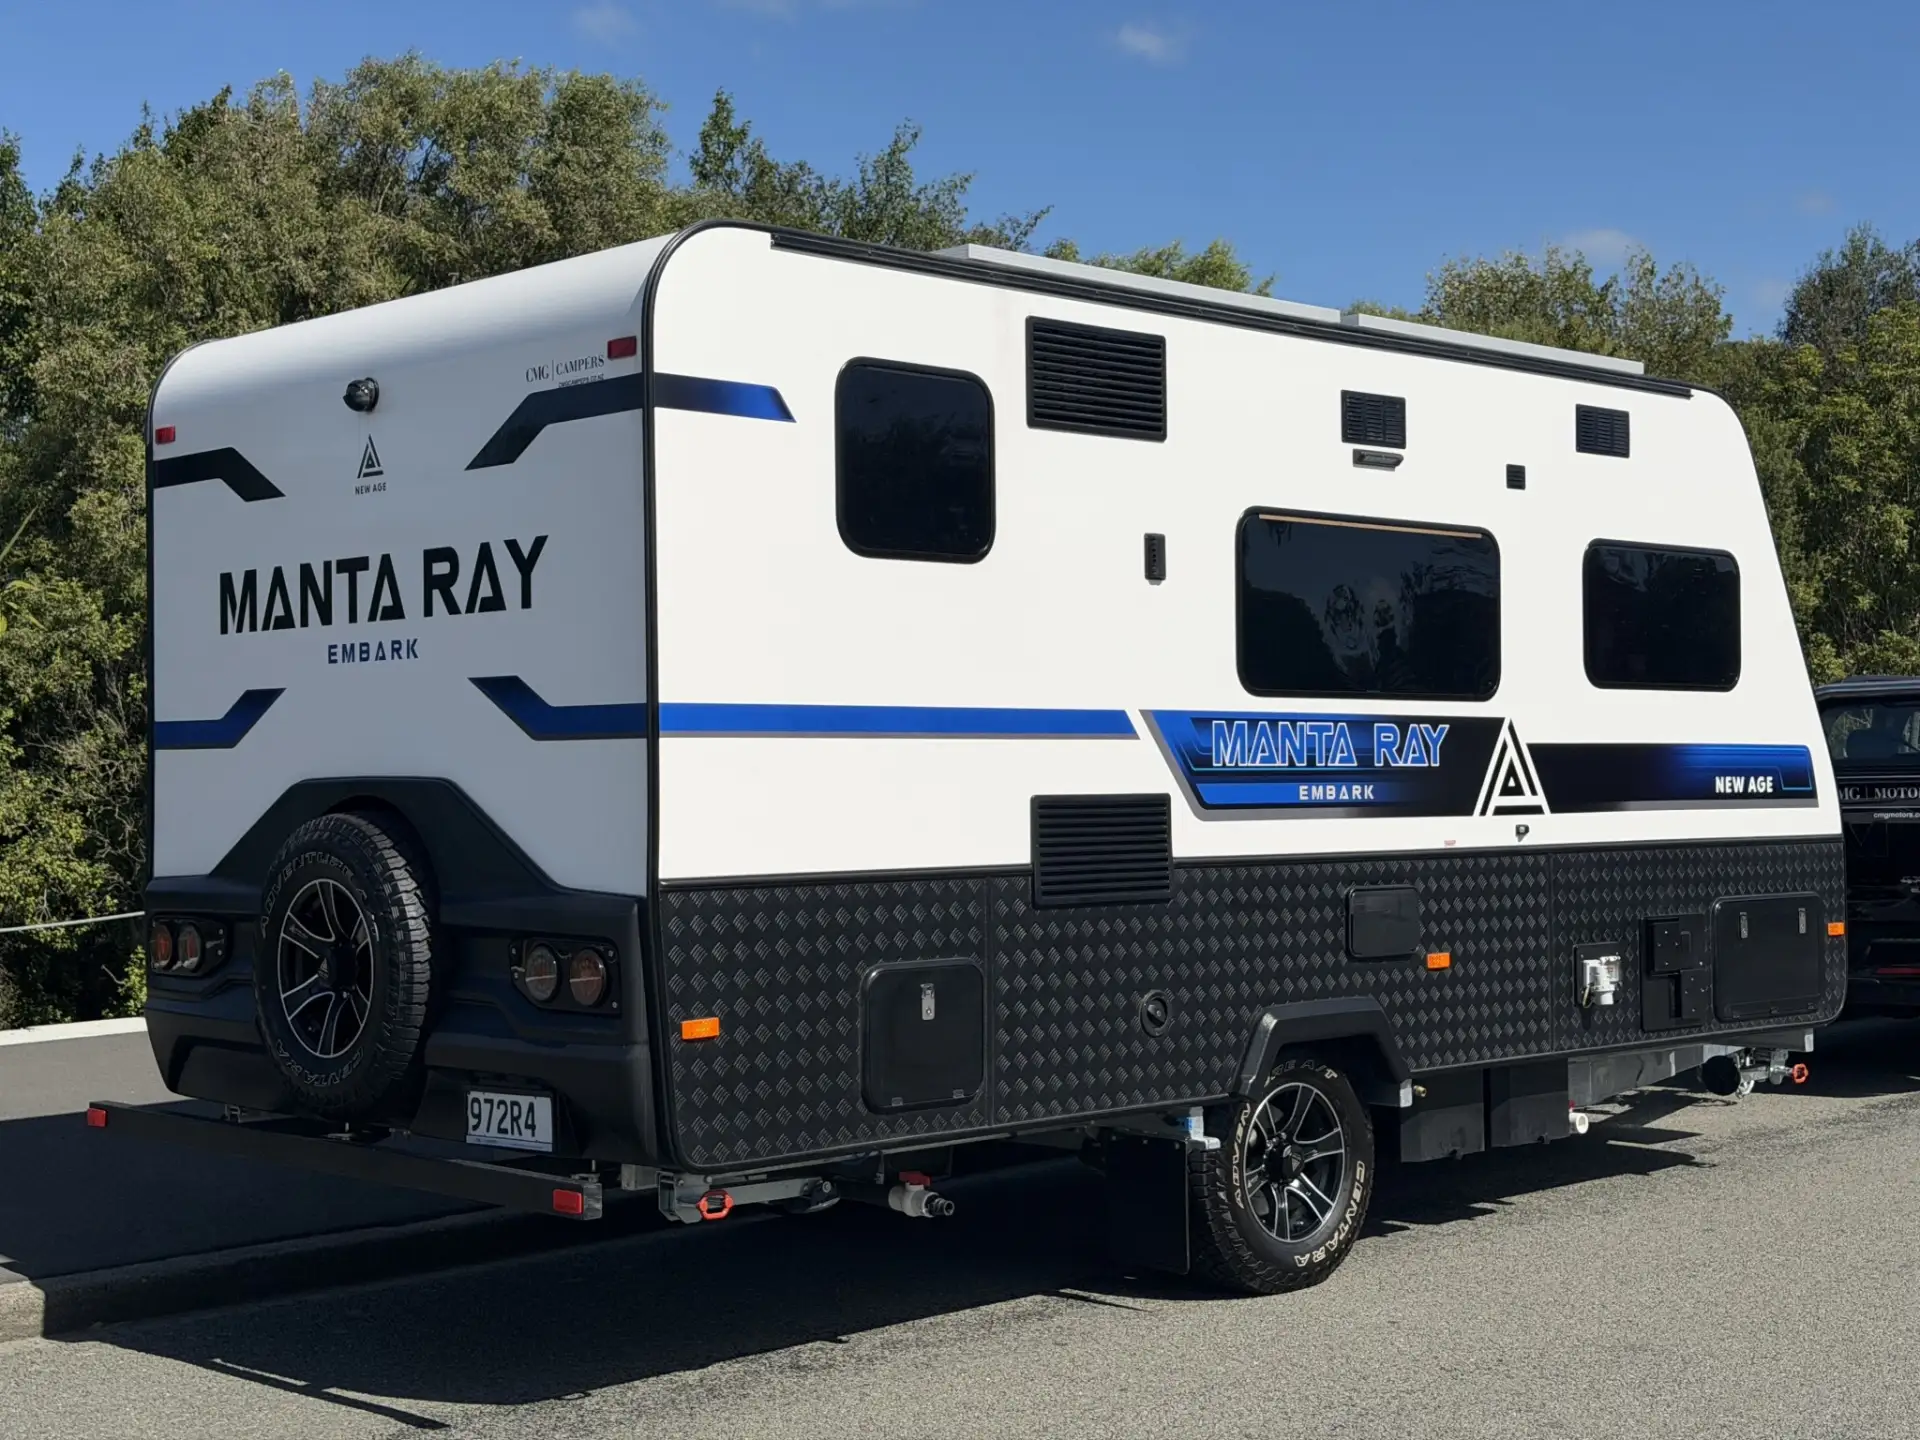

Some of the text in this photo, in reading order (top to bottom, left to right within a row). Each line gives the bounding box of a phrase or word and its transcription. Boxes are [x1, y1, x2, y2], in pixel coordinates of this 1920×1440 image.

[526, 354, 605, 383] CMG CAMPERS
[355, 482, 386, 495] NEW AGE
[219, 535, 549, 635] MANTA RAY
[327, 638, 419, 665] EMBARK
[1212, 720, 1450, 768] MANTA RAY
[1298, 784, 1376, 801] EMBARK
[1715, 775, 1774, 793] NEW AGE
[1838, 785, 1920, 801] MG MOTO
[470, 1097, 537, 1138] 972R4
[1293, 1160, 1366, 1268] CENTARA
